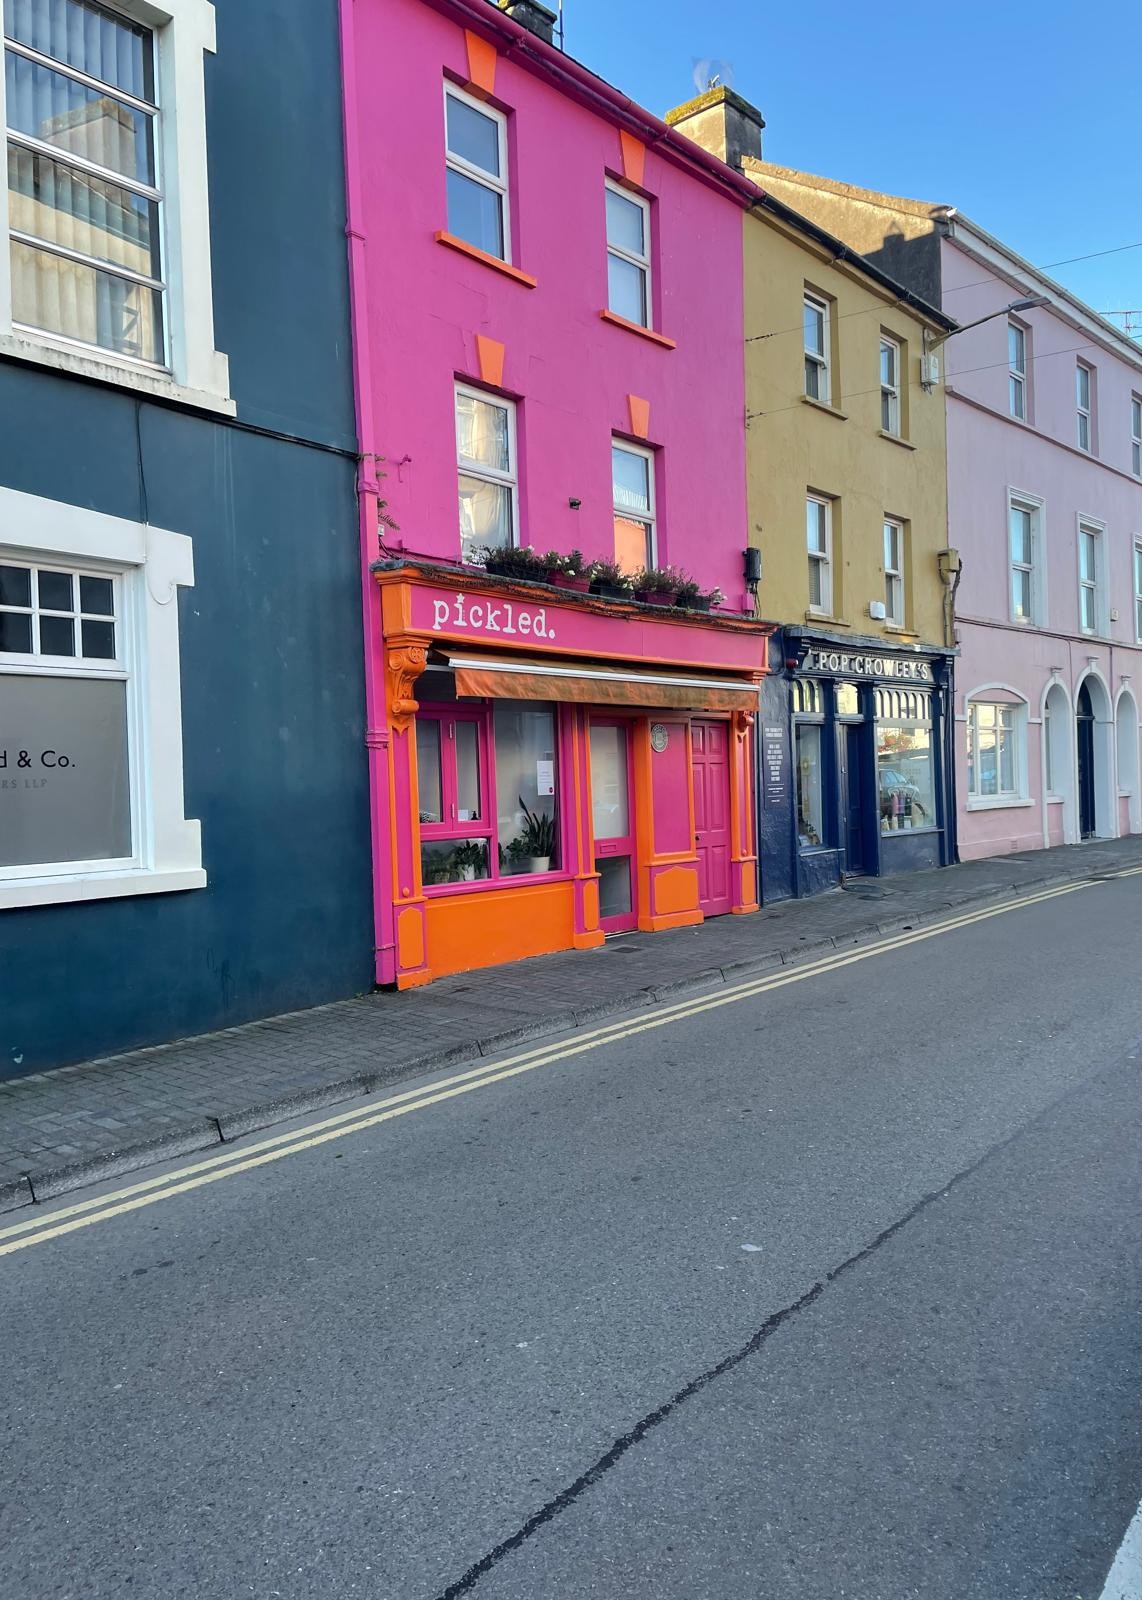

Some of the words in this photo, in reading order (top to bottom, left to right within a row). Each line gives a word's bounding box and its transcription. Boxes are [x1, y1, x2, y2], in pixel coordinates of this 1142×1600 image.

[432, 592, 556, 639] pickled.
[820, 652, 849, 672] POP
[855, 656, 928, 680] CROWLEY'S
[17, 750, 32, 768] &
[41, 750, 76, 768] Co.
